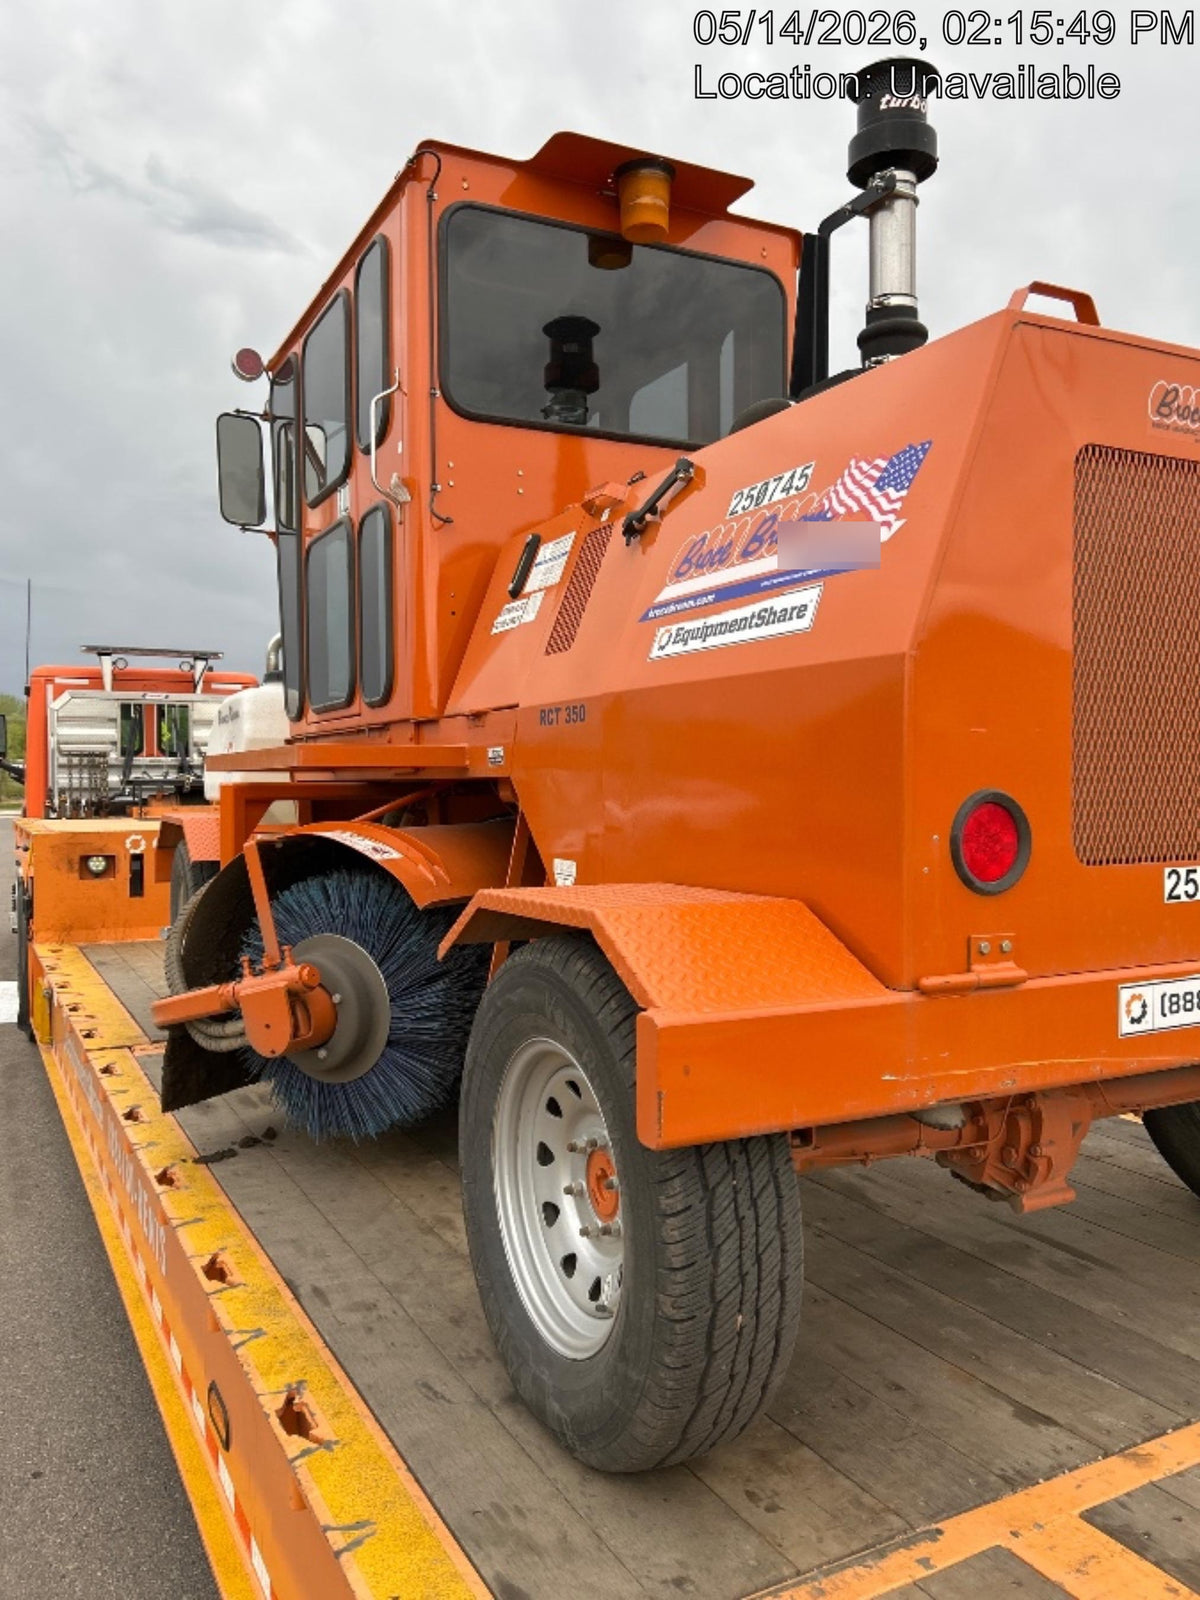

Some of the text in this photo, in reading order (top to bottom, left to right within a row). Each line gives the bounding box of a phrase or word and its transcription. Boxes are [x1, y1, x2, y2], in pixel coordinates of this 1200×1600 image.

[729, 464, 814, 516] 250745
[671, 603, 808, 646] EquipmentShare
[539, 704, 586, 726] RCT 350
